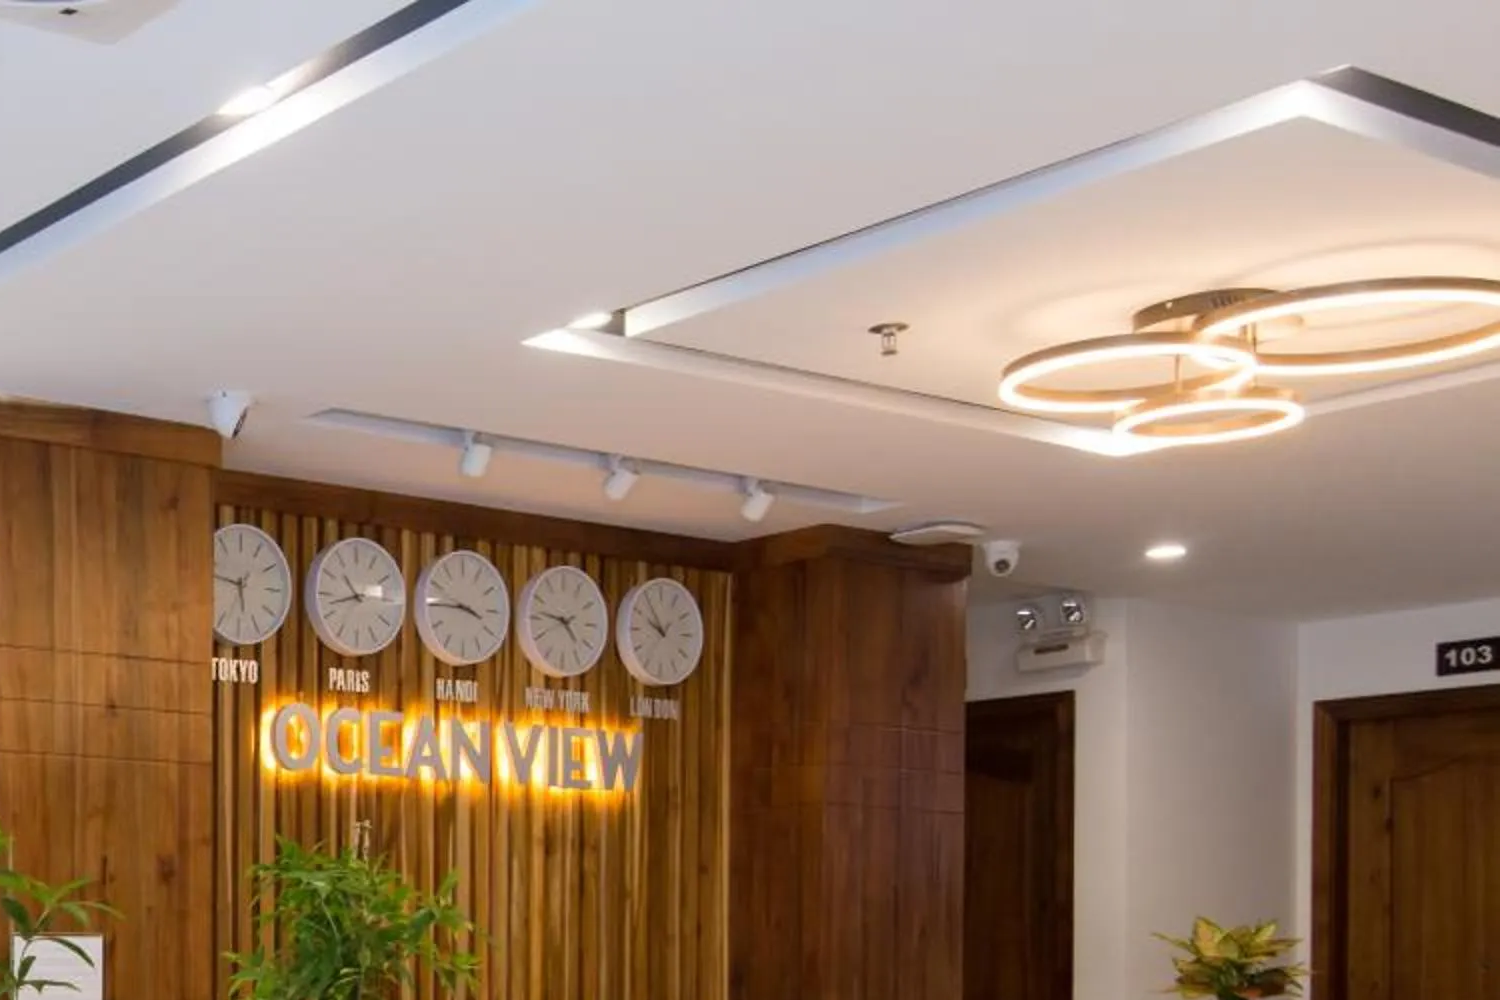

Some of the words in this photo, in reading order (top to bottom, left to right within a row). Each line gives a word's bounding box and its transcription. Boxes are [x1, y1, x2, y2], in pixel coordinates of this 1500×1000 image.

[1444, 645, 1493, 668] 103
[211, 656, 259, 684] TOKYO
[328, 667, 370, 693] PARIS
[436, 678, 479, 703] HANOI
[525, 686, 555, 710] NEW
[558, 689, 591, 714] YORK
